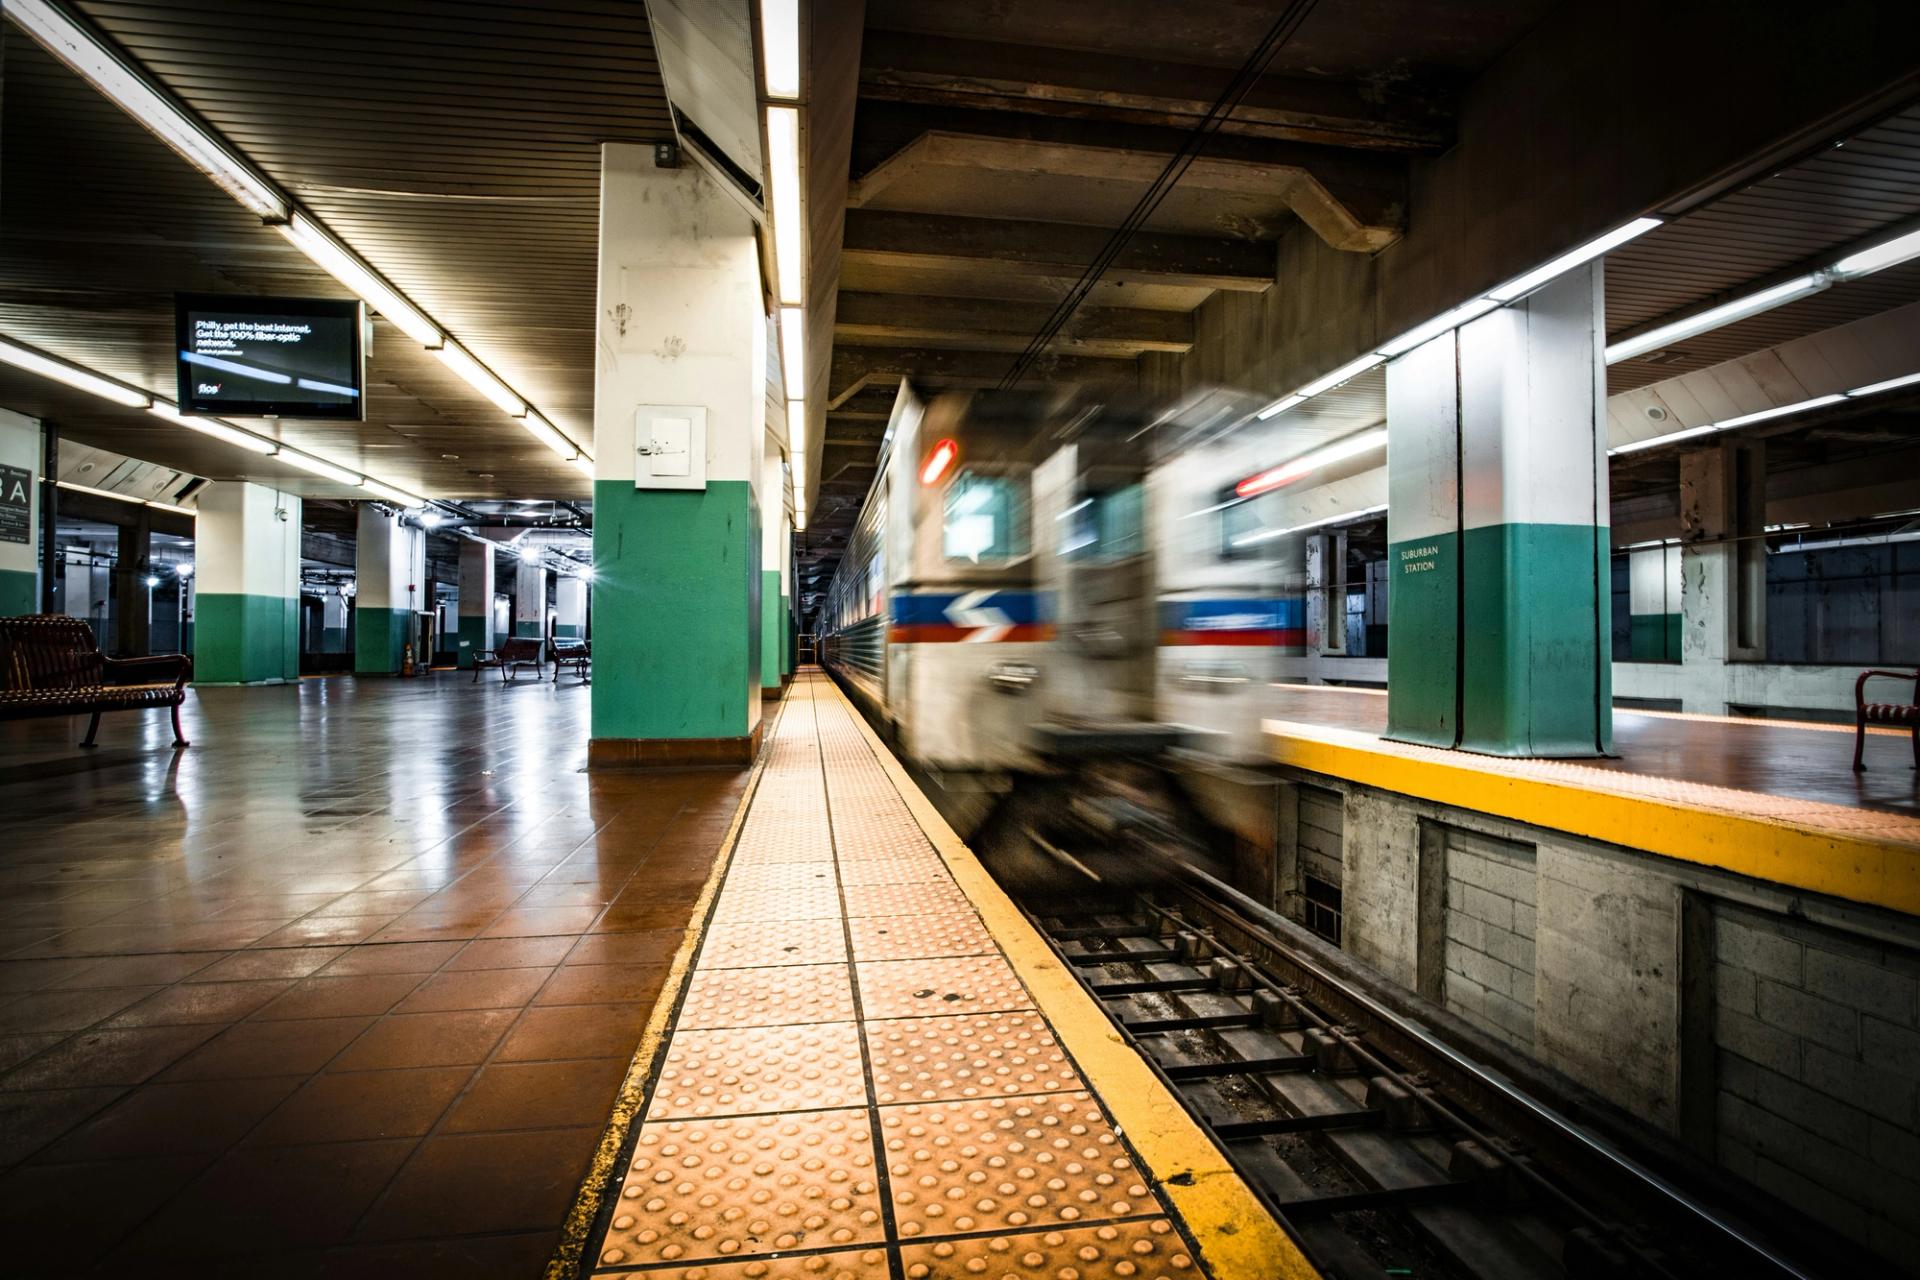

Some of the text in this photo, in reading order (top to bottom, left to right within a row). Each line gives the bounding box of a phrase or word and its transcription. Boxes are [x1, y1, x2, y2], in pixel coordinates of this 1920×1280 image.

[196, 320, 311, 334] Philly, get the best internet.
[196, 329, 301, 342] Get the 100% fiber-optic
[196, 339, 237, 348] network.
[1401, 546, 1439, 560] SUBURBAN
[1405, 561, 1435, 574] STATION
